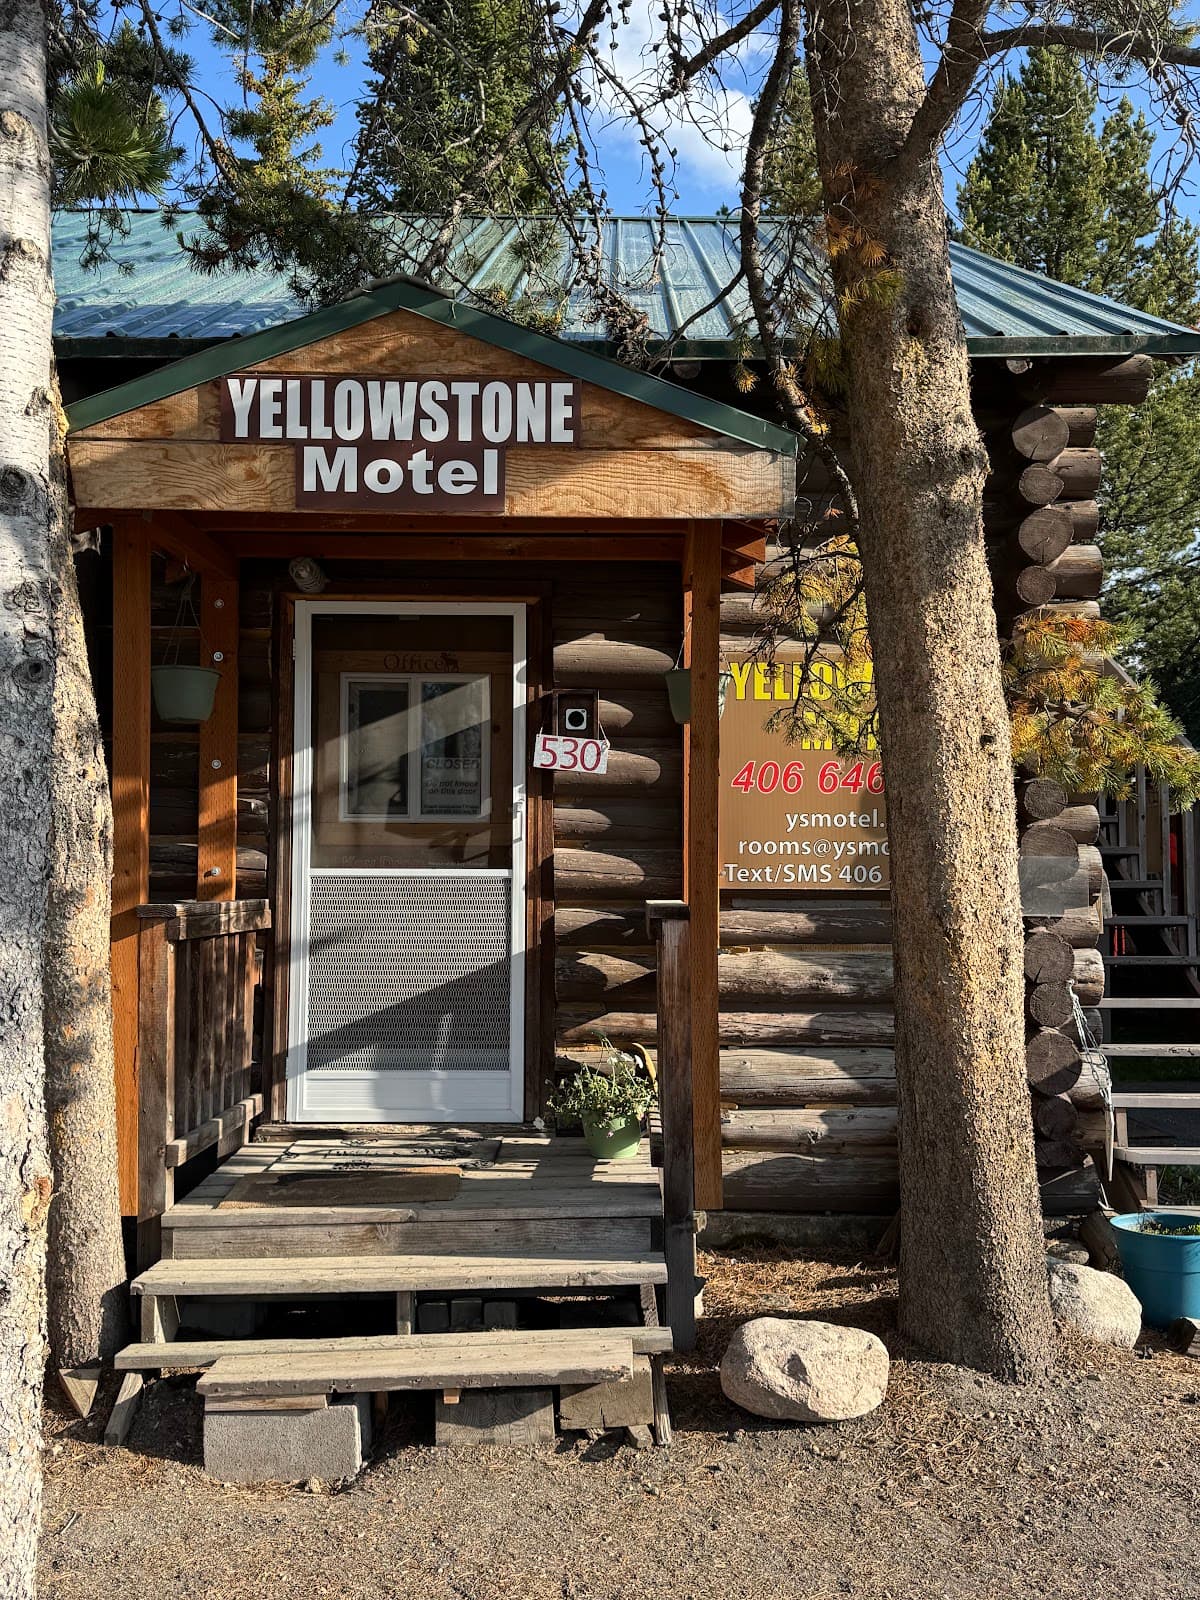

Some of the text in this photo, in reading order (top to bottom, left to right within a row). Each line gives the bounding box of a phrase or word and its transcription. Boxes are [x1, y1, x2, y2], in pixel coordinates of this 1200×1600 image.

[227, 378, 575, 443] YELLOWSTONE
[303, 446, 499, 495] Motel
[384, 652, 445, 671] Office
[426, 758, 480, 769] CLOSED
[540, 737, 602, 771] 530
[440, 780, 453, 788] not
[454, 780, 479, 788] knock
[731, 760, 886, 794] 406 646
[785, 808, 885, 832] ysmotel.
[724, 863, 883, 883] Text/SMS 406
